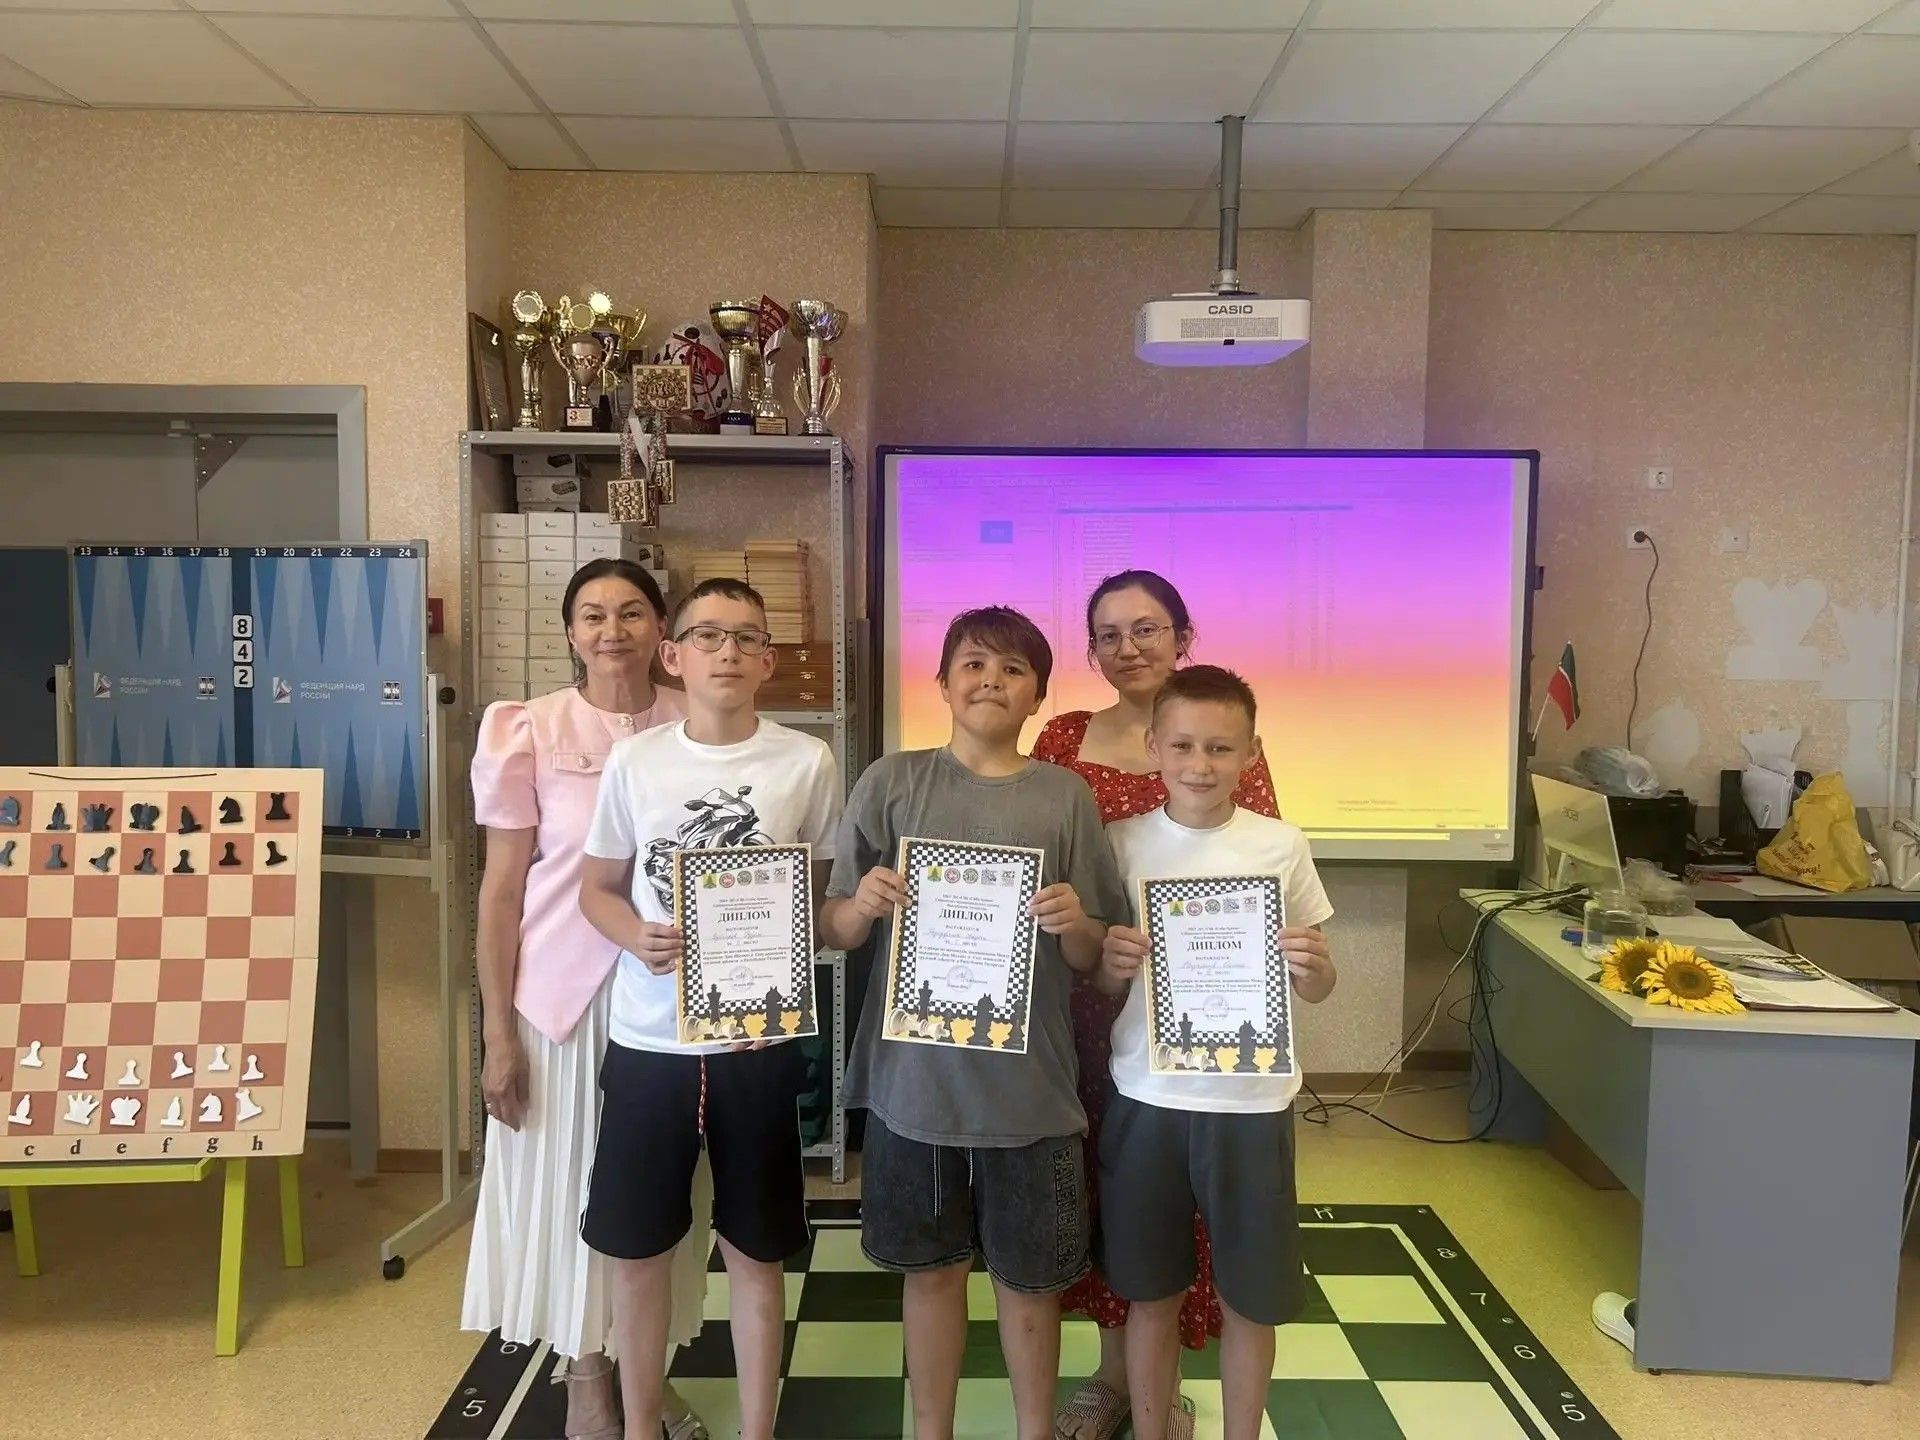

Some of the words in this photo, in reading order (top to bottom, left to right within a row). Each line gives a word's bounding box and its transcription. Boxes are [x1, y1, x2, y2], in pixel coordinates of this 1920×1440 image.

[1208, 305, 1253, 315] CASIO
[622, 493, 631, 506] 2
[80, 547, 92, 556] 13
[107, 547, 119, 556] 14
[134, 547, 146, 556] 15
[162, 547, 174, 556] 16
[189, 548, 201, 556] 17
[217, 548, 230, 557] 18
[255, 548, 267, 557] 19
[283, 548, 295, 557] 20
[311, 548, 323, 557] 21
[340, 548, 352, 557] 22
[369, 548, 381, 557] 23
[398, 549, 411, 557] 24
[237, 618, 248, 635] 8
[237, 643, 249, 660] 4
[238, 668, 249, 685] 2
[346, 827, 353, 837] 3
[375, 829, 382, 838] 2
[405, 830, 412, 839] 1
[718, 911, 771, 923] ДИПЛОМ
[939, 908, 994, 923] ДИПЛОМ
[1187, 940, 1242, 952] ДИПЛОМ
[23, 1144, 35, 1156] c
[70, 1139, 82, 1155] d
[116, 1142, 128, 1154] e
[161, 1136, 173, 1154] f
[207, 1136, 220, 1154] g
[252, 1135, 264, 1151] h
[1436, 1247, 1458, 1259] 8
[1470, 1292, 1487, 1306] 7
[500, 1341, 518, 1354] 6
[1513, 1344, 1537, 1360] 6
[462, 1399, 487, 1417] 5
[1560, 1403, 1586, 1422] 5
